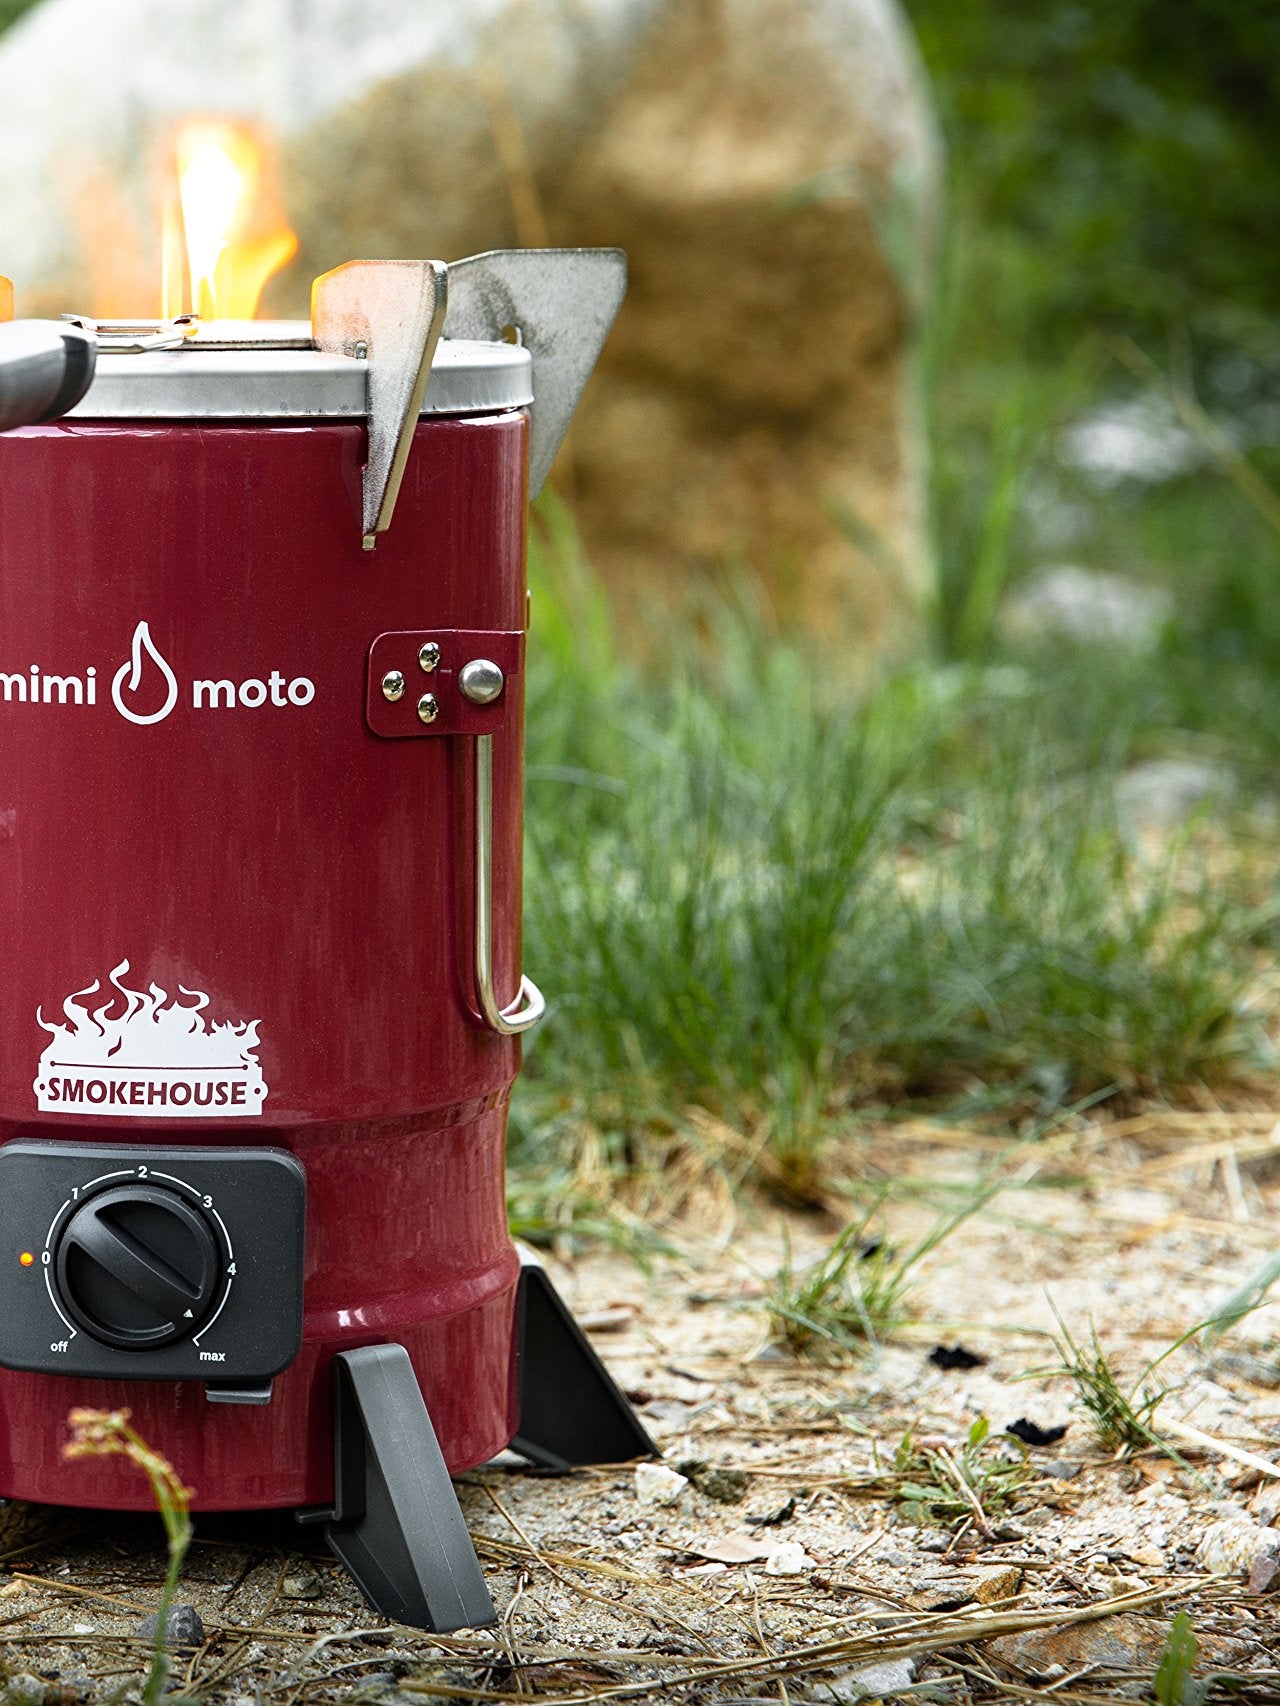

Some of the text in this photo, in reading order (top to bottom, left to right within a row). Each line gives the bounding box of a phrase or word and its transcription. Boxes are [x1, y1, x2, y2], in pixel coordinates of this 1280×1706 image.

[192, 670, 315, 708] moto
[47, 1077, 247, 1106] SMOKEHOUSE
[137, 1165, 148, 1179] 2
[71, 1187, 80, 1200] 1
[202, 1194, 213, 1208] 3
[40, 1251, 51, 1265] 0
[227, 1262, 237, 1276] 4
[50, 1340, 69, 1353] off
[199, 1350, 226, 1363] max
